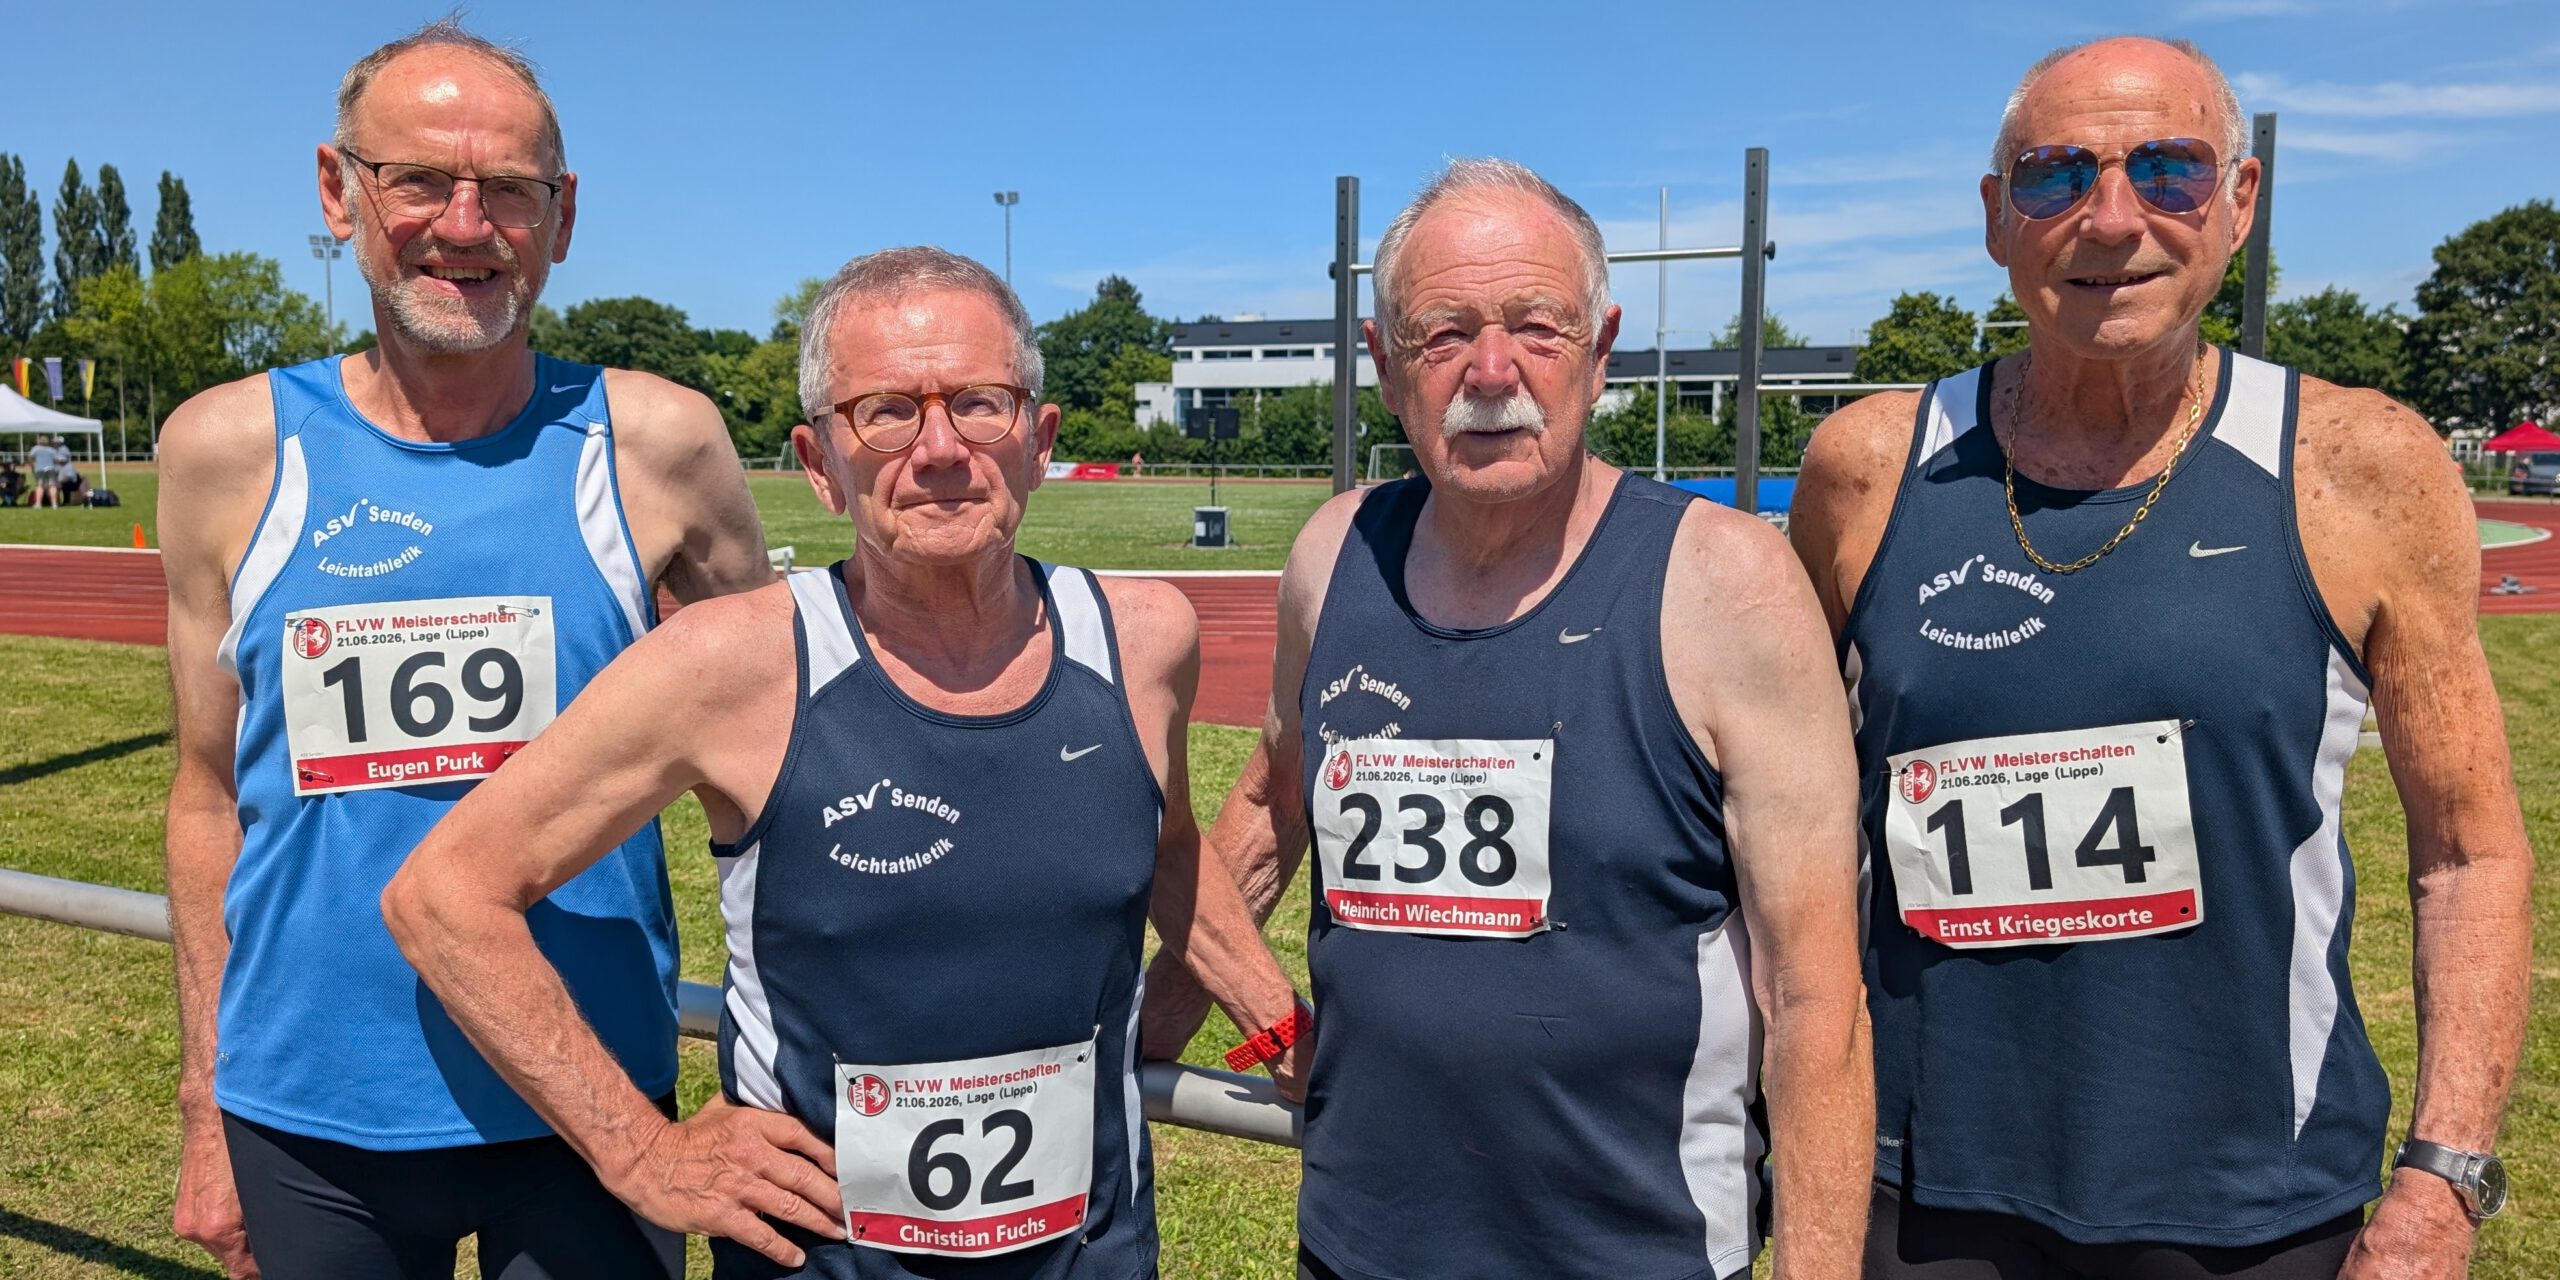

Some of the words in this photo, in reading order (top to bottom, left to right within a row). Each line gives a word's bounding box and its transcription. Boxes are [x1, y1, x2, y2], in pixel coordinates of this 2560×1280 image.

[313, 501, 359, 548] ASV
[369, 505, 434, 536] Senden
[318, 545, 423, 578] Leichtathletik
[1918, 557, 1975, 605] ASV
[1982, 564, 2055, 604] Senden
[335, 618, 385, 635] FLVW
[392, 612, 516, 630] Meisterschaften
[337, 634, 406, 648] 21.06.2026,
[410, 631, 440, 644] Lage
[446, 627, 489, 644] (Lippe)
[1919, 616, 2046, 650] Leichtathletik
[323, 648, 524, 743] 169
[1320, 666, 1356, 709] ASV
[1359, 674, 1411, 710] Senden
[367, 760, 430, 780] Eugen
[437, 752, 485, 771] Purk
[1356, 754, 1397, 768] FLVW
[1402, 755, 1515, 770] Meisterschaften
[1940, 758, 1986, 777] FLVW
[1994, 744, 2136, 768] Meisterschaften
[1940, 774, 2011, 789] 21.06.2026,
[2015, 770, 2050, 783] Lage
[2055, 762, 2104, 780] (Lippe)
[1355, 772, 1414, 784] 21.06.2026,
[1418, 773, 1447, 784] Lage
[1451, 772, 1488, 785] (Lippe)
[823, 781, 881, 828] ASV
[891, 788, 960, 824] Senden
[829, 838, 954, 874] Leichtathletik
[1340, 793, 1517, 887] 238
[1926, 786, 2156, 896] 114
[1339, 900, 1400, 919] Heinrich
[1405, 904, 1522, 926] Wiechmann
[1938, 920, 1993, 938] Ernst
[1998, 907, 2153, 938] Kriegeskorte
[894, 1080, 943, 1093] FLVW
[949, 1063, 1061, 1092] Meisterschaften
[855, 1083, 863, 1107] FLVW
[895, 1095, 963, 1108] 21.06.2026,
[966, 1091, 995, 1104] Lage
[999, 1083, 1038, 1100] (Lippe)
[908, 1109, 1034, 1211] 62
[899, 1224, 989, 1247] Christian
[996, 1218, 1046, 1240] Fuchs
